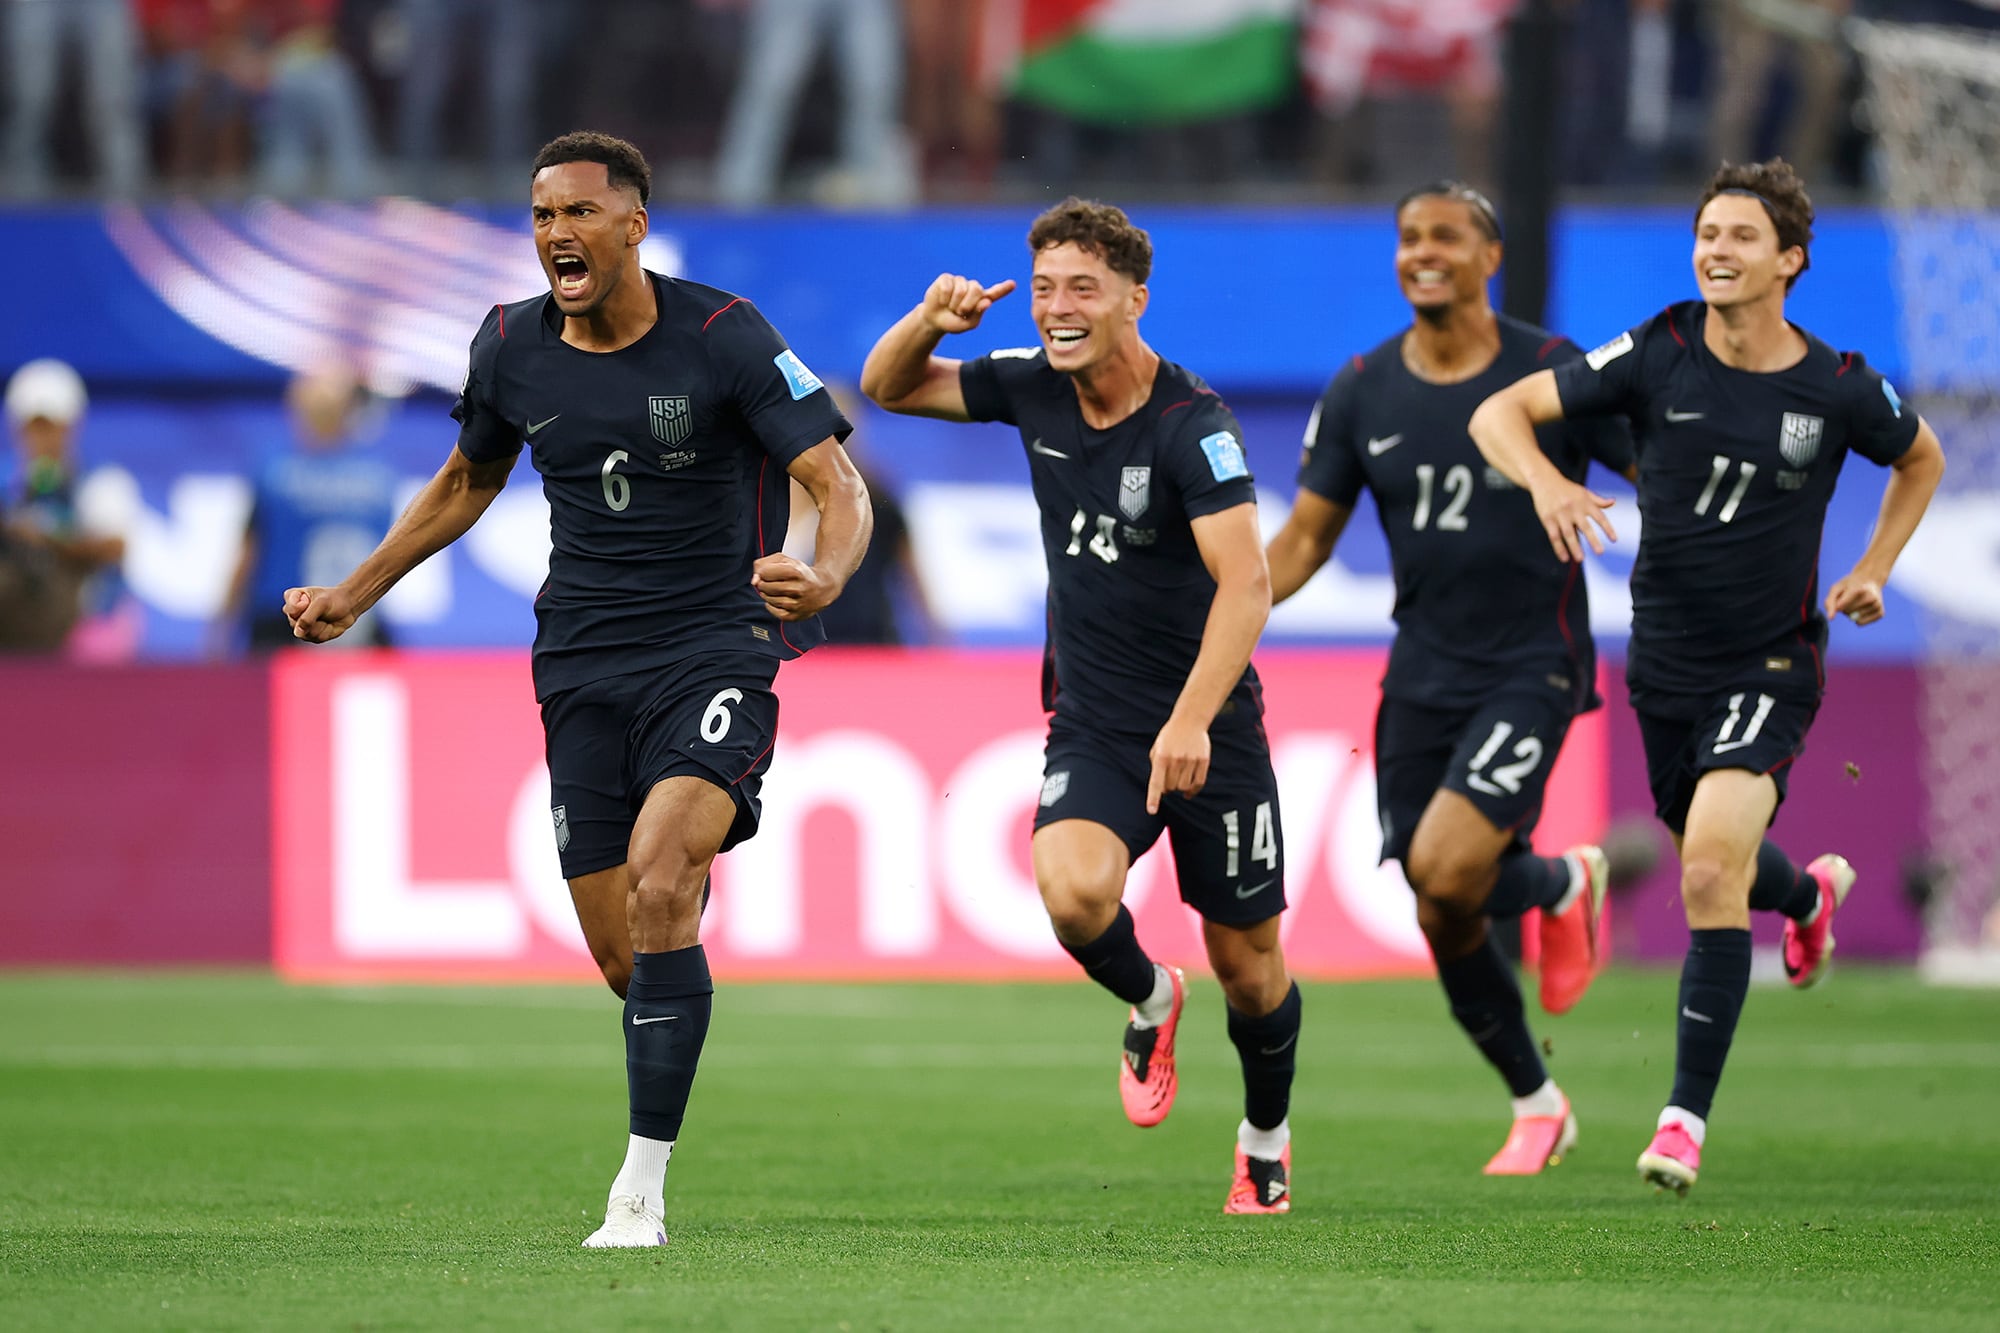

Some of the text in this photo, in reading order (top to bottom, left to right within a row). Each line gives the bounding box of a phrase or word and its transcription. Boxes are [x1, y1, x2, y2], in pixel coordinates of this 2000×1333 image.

[652, 399, 687, 420] USA
[1786, 416, 1819, 440] USA
[601, 449, 630, 512] 6
[1122, 469, 1147, 491] USA
[1412, 463, 1474, 532] 12
[1693, 454, 1758, 524] 11
[1065, 507, 1120, 564] 14
[700, 687, 744, 744] 6
[1715, 692, 1776, 744] 11
[1468, 720, 1543, 795] 12
[1222, 800, 1277, 877] 14
